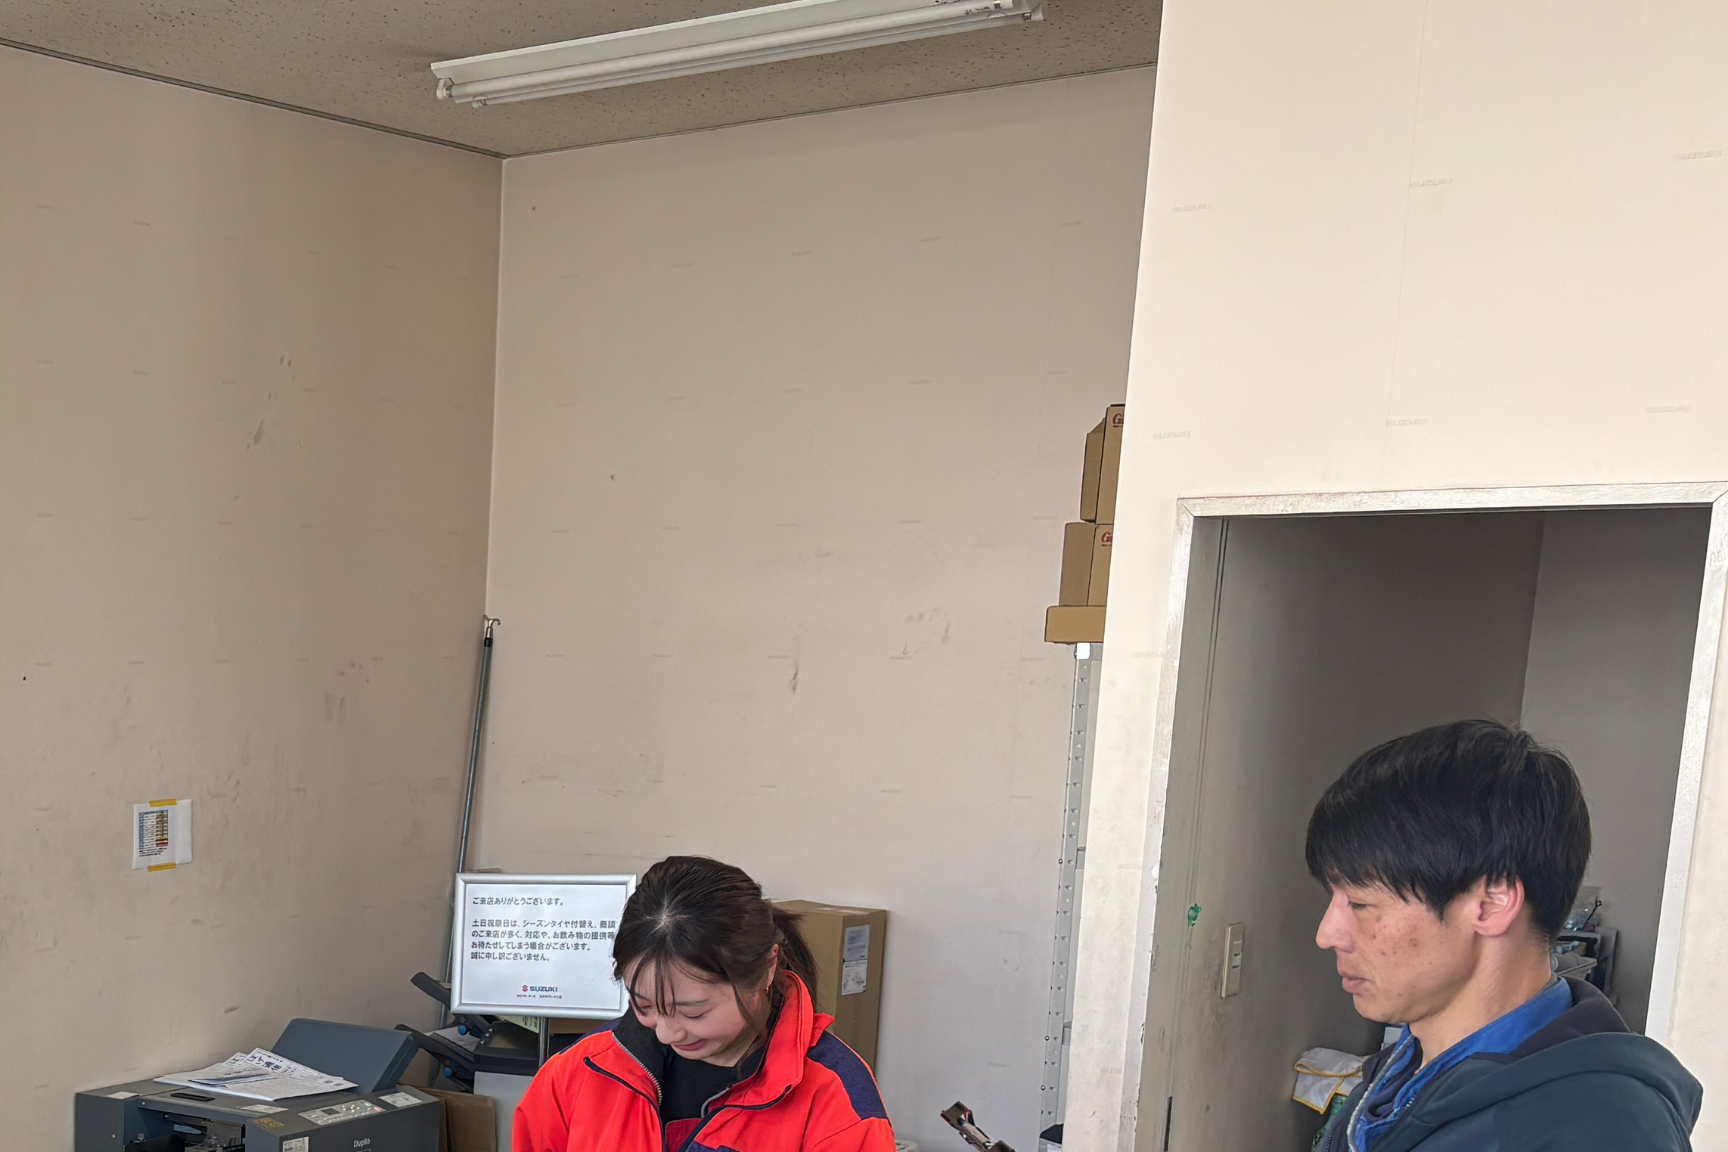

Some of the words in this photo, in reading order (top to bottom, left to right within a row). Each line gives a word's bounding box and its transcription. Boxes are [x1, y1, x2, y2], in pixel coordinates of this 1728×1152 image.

[472, 897, 563, 906] ご来店ありがとうございます。
[471, 942, 590, 951] お待たせしてしまう場合がございます。
[471, 952, 550, 961] 誠に申し訳ございません。
